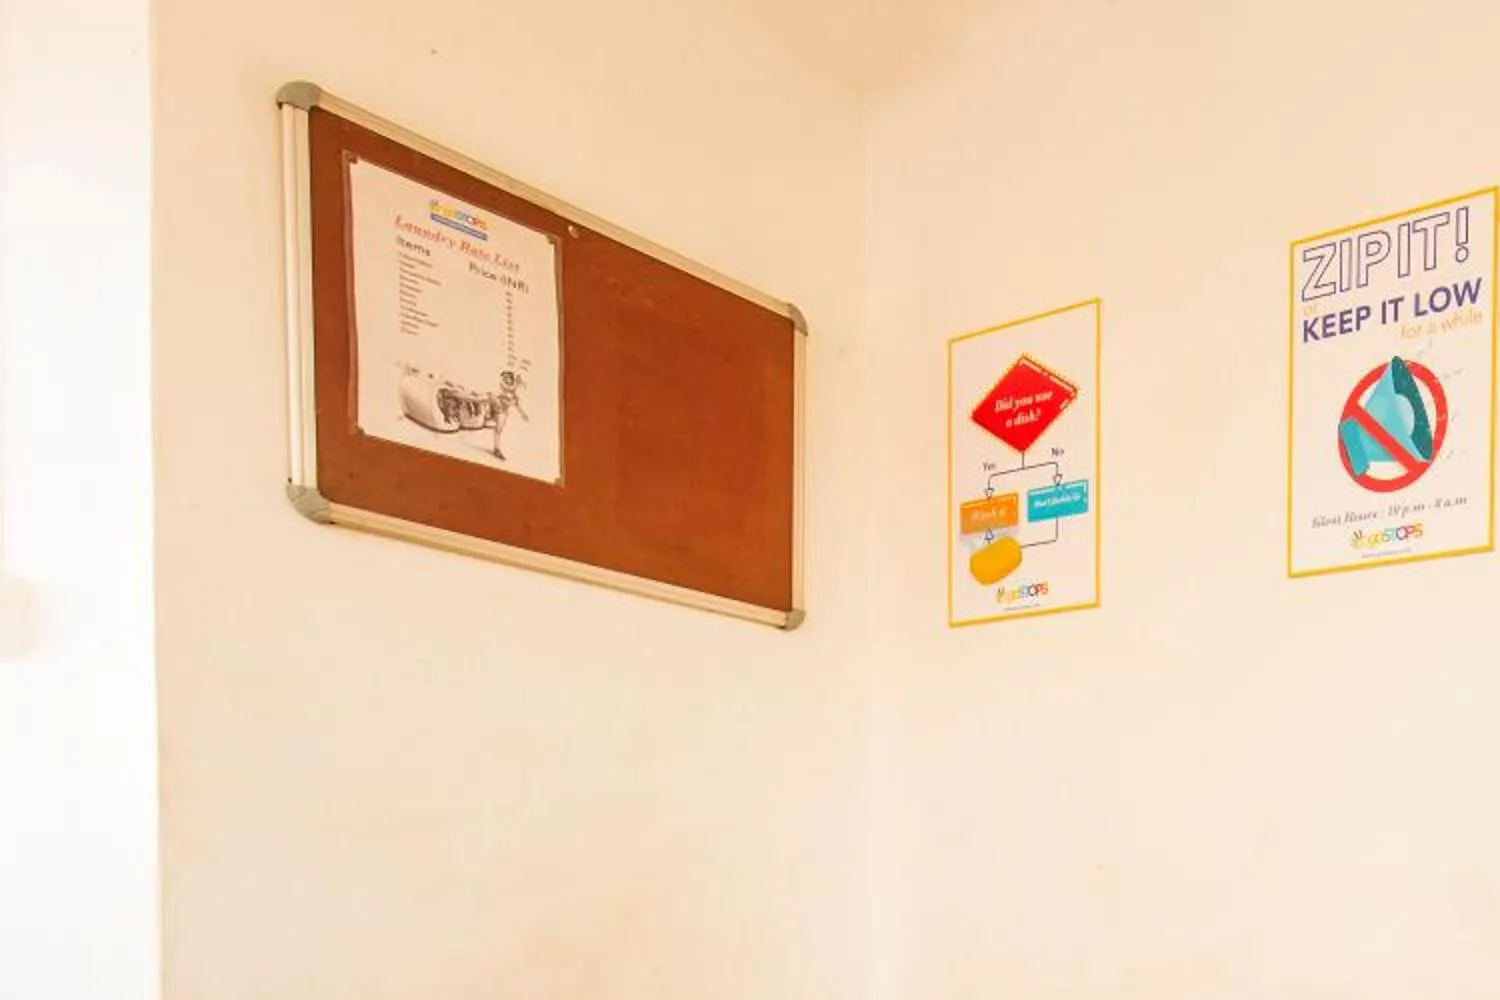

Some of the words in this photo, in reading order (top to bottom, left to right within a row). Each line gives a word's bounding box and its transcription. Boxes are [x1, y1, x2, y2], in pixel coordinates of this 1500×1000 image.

[395, 214, 456, 249] Laundry
[461, 240, 491, 262] Rate
[495, 253, 520, 272] List
[396, 235, 431, 257] Items
[469, 261, 497, 281] Price
[1302, 305, 1371, 343] KEEP
[1381, 296, 1405, 325] IT
[1414, 277, 1482, 317] LOW
[1402, 322, 1422, 339] for
[1426, 323, 1436, 335] a
[1441, 308, 1483, 332] while
[994, 396, 1013, 413] Did
[1013, 396, 1033, 412] you
[1051, 447, 1065, 456] No
[982, 461, 997, 472] Yes
[1311, 514, 1341, 529] Silent
[1344, 510, 1379, 523] Hours
